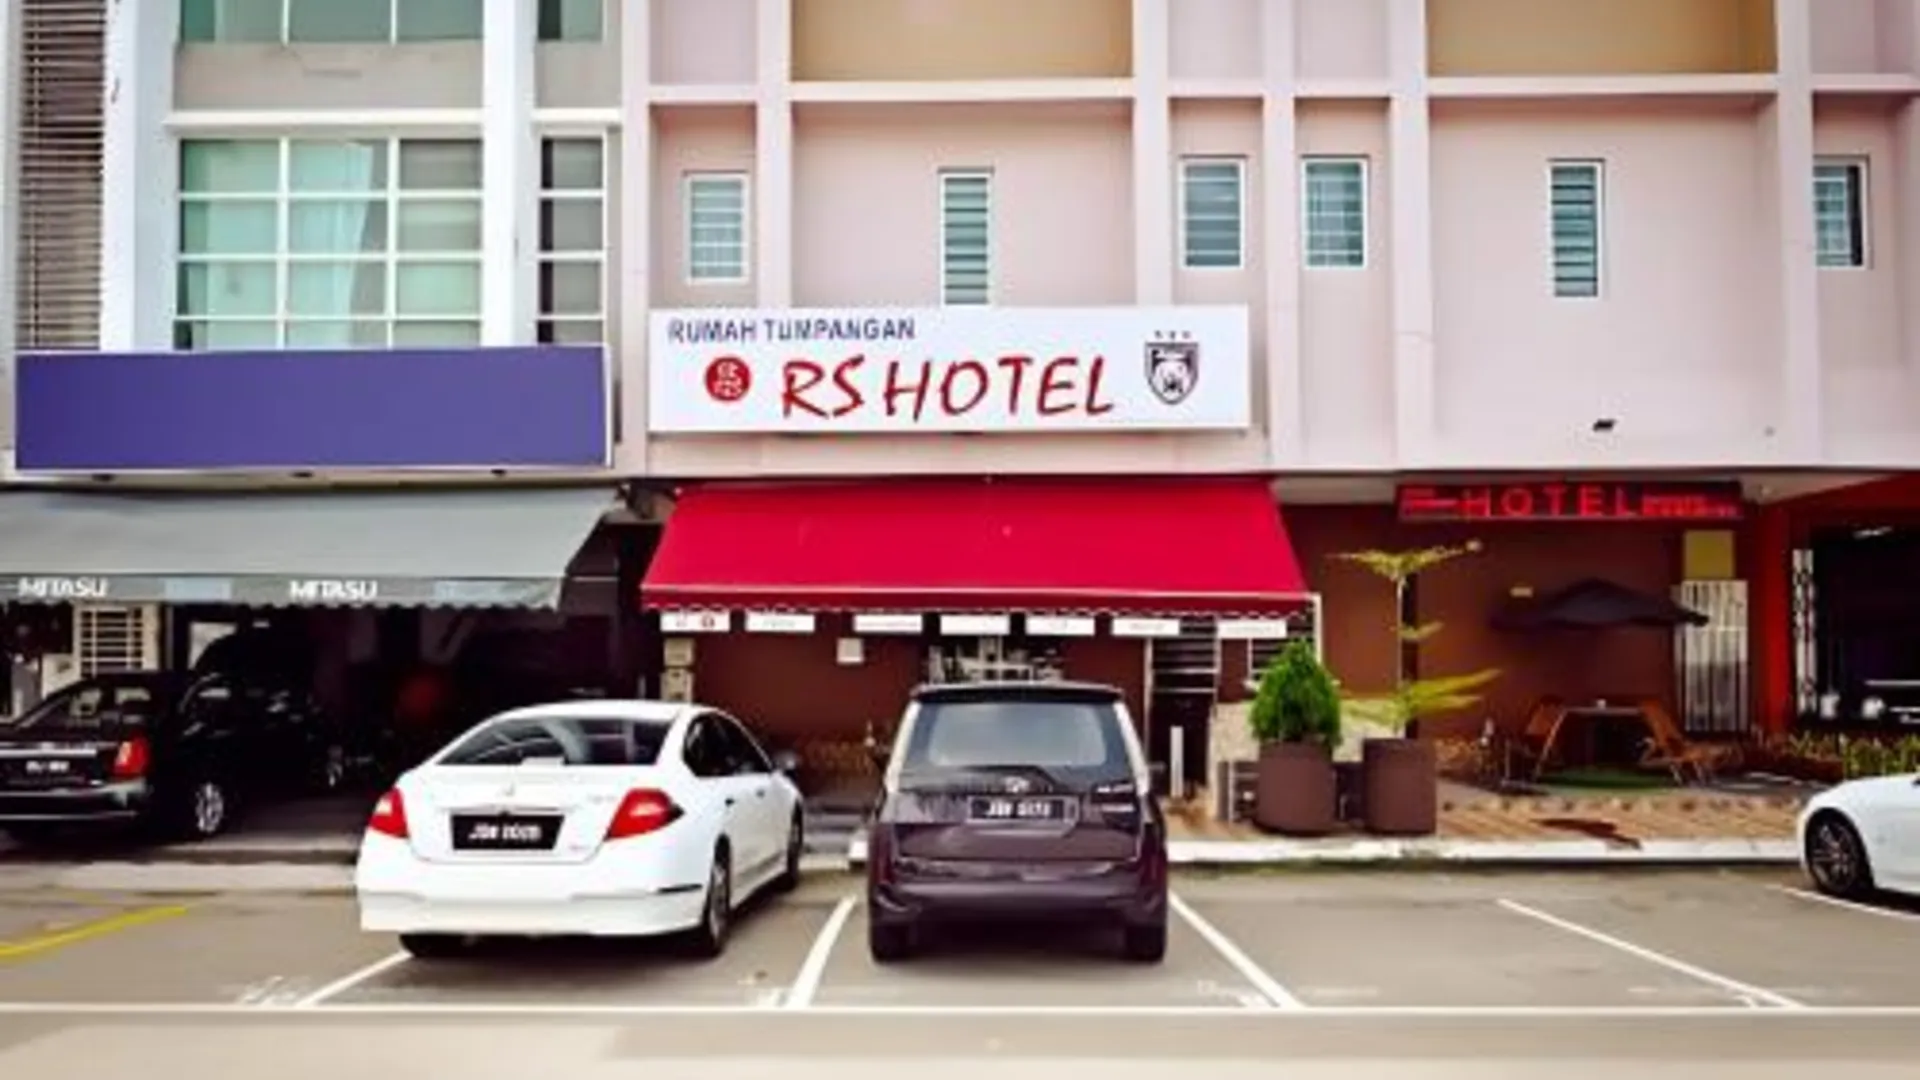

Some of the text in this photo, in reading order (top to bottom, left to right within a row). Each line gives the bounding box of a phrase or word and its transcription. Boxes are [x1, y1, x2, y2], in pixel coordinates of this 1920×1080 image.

[668, 317, 916, 343] RUMAH TUMPANGAN
[780, 354, 866, 420] RS
[882, 355, 1114, 422] HOTEL
[288, 579, 378, 599] MITASU
